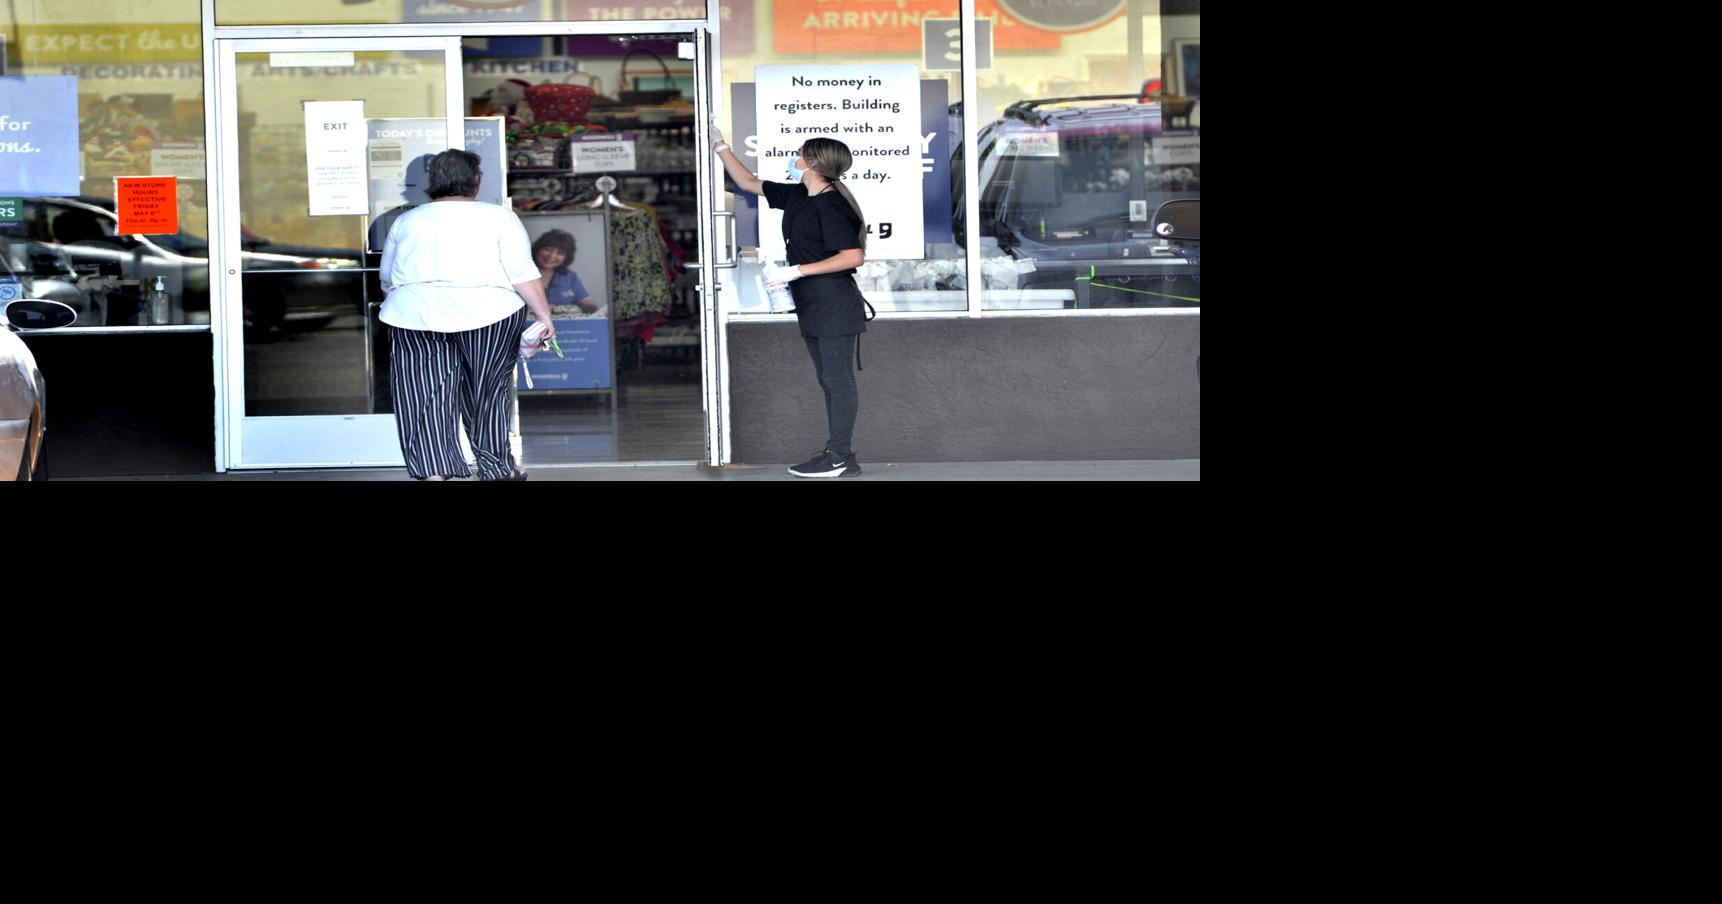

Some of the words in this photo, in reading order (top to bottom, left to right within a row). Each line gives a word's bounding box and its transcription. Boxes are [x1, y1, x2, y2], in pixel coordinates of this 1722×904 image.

[589, 7, 635, 20] THE
[644, 6, 731, 20] POWR
[27, 34, 128, 51] EXPECT
[137, 31, 176, 49] the
[473, 60, 578, 74] KITCHEN
[792, 76, 813, 87] No
[817, 79, 864, 90] money
[868, 76, 882, 86] in
[774, 101, 837, 114] registers.
[842, 99, 901, 113] Building
[0, 115, 31, 131] for
[323, 122, 348, 131] EXIT
[780, 123, 791, 134] is
[795, 123, 838, 133] armed
[843, 123, 873, 133] with
[375, 130, 421, 138] TODAY'S
[852, 146, 910, 157] onitored
[862, 169, 891, 183] day.
